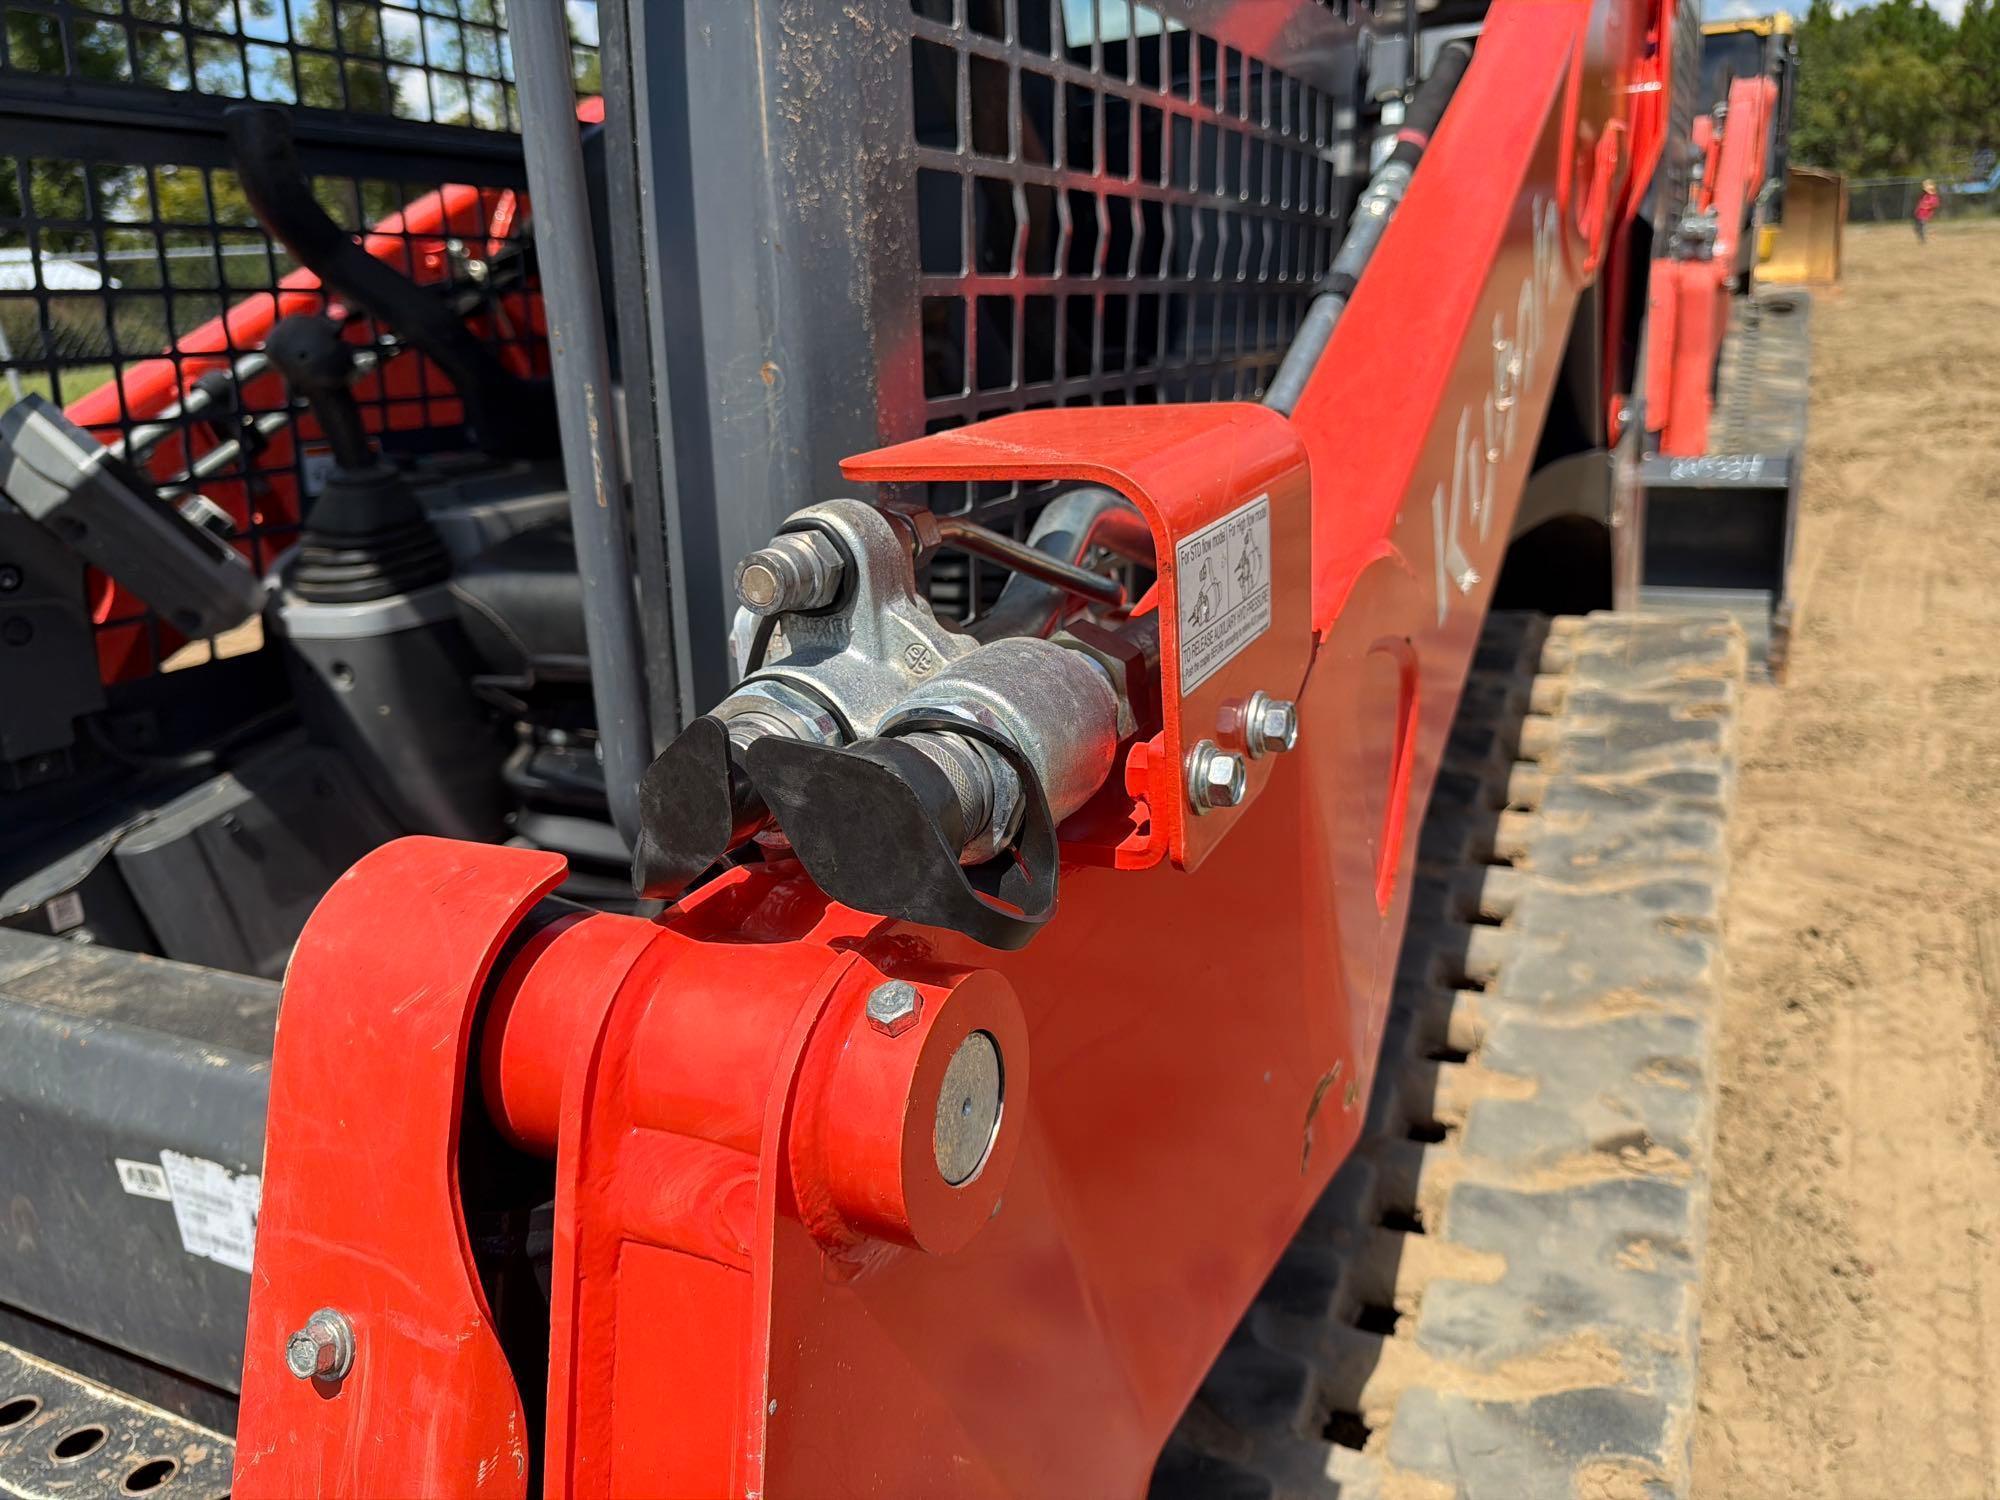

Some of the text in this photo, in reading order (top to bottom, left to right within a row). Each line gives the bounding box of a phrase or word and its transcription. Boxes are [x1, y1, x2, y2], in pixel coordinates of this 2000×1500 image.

[1228, 522, 1236, 538] For
[1236, 515, 1246, 535] High
[1180, 528, 1226, 566] For STD flow model
[1183, 646, 1191, 664] TO
[1192, 630, 1213, 659] RELEASE
[1214, 613, 1237, 642] AUXILIARY
[1246, 588, 1268, 616] PRESSURE
[1211, 640, 1224, 659] BEFORE
